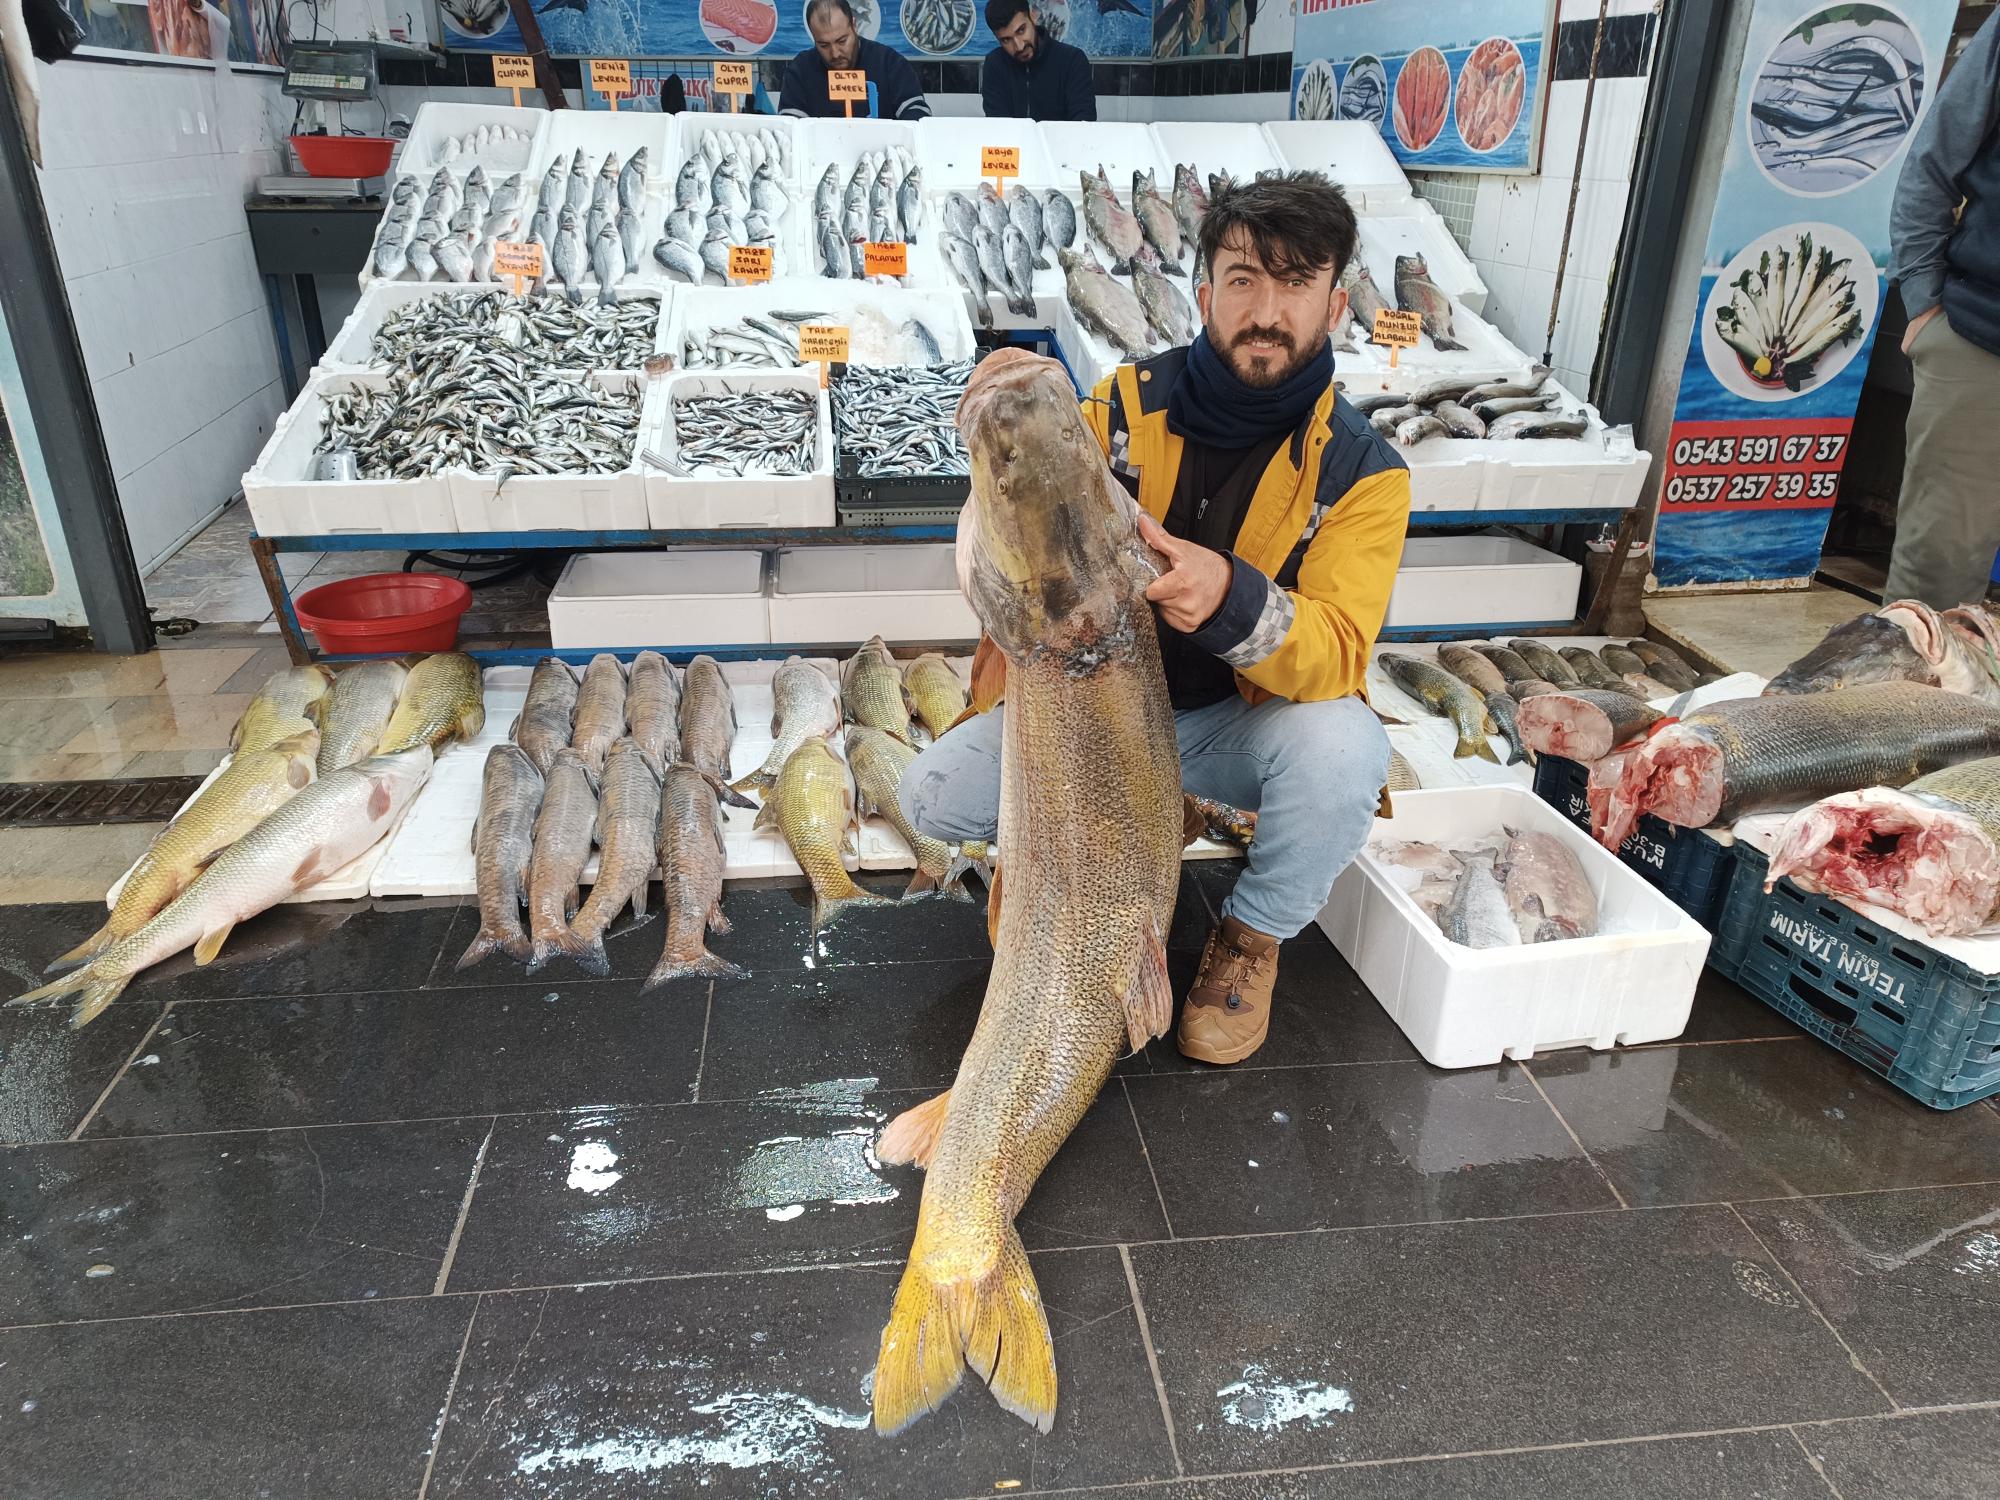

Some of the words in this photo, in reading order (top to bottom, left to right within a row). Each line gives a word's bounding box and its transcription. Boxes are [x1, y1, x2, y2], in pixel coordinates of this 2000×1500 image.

[720, 64, 746, 74] OLTA
[834, 72, 858, 81] OLTA
[830, 84, 864, 93] LEVREK
[733, 266, 768, 275] KANAT
[1376, 320, 1419, 331] MUNZUR
[1673, 437, 1735, 466] 0543
[1737, 436, 1779, 463] 591
[1782, 436, 1814, 462] 67
[1814, 435, 1847, 461] 37
[1666, 475, 1725, 503] 0537
[1727, 474, 1772, 501] 257
[1773, 473, 1805, 499] 39
[1807, 473, 1838, 498] 35
[1769, 910, 1831, 963] TARIM
